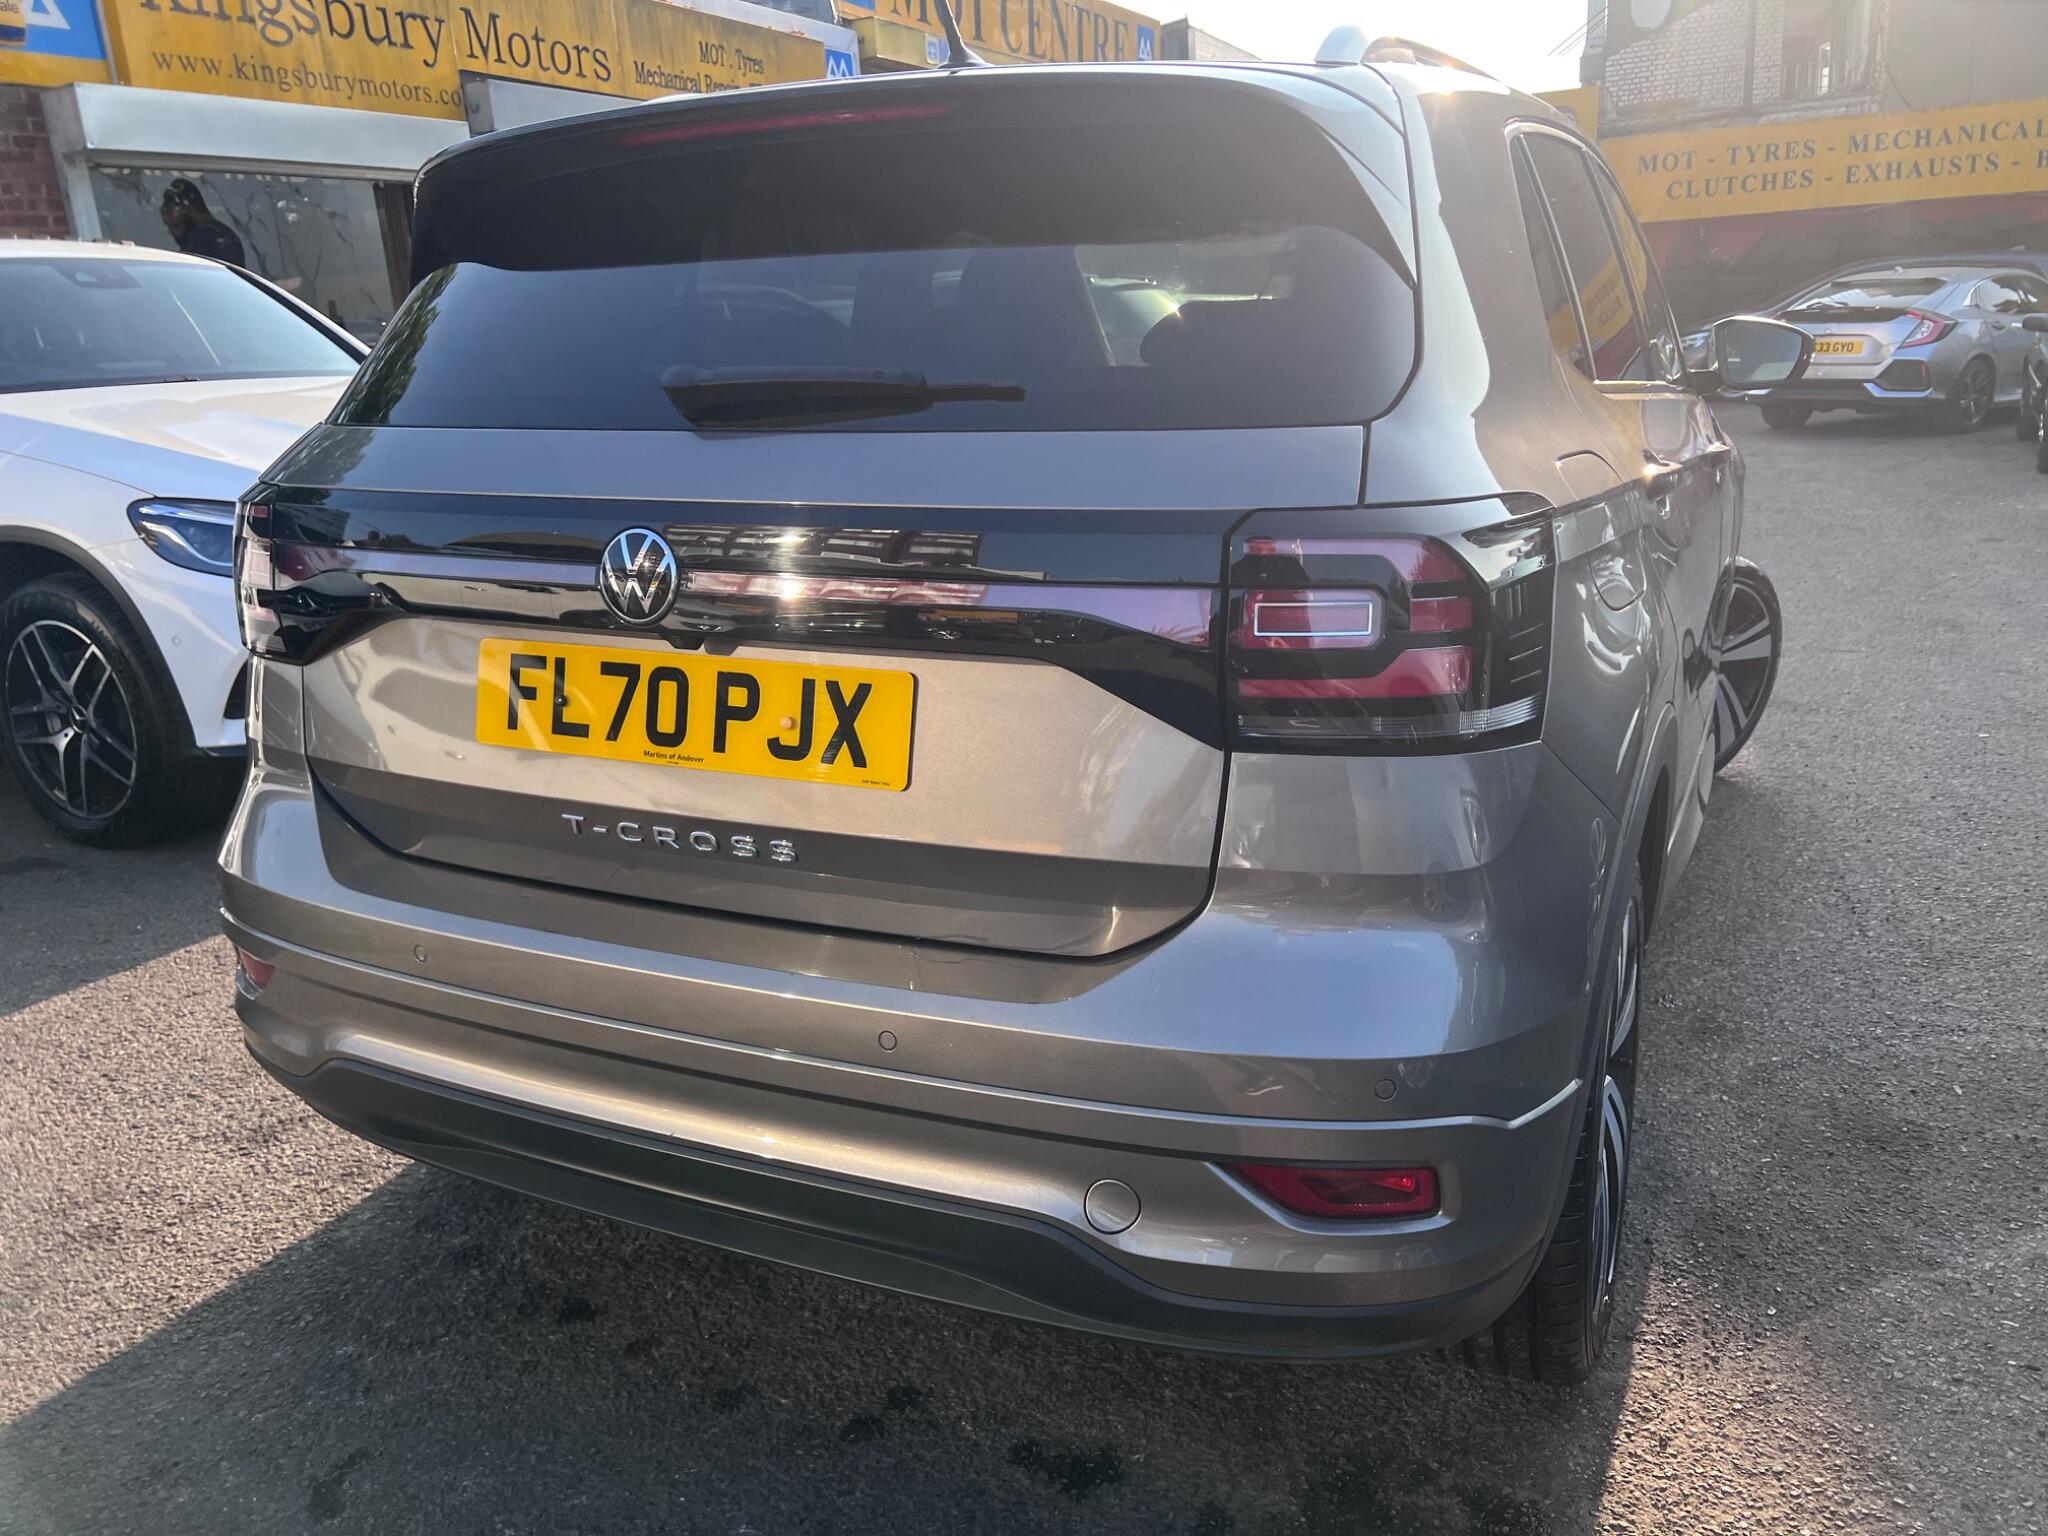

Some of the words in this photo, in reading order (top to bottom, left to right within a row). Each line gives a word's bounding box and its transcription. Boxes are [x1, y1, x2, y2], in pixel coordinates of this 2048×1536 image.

[140, 0, 446, 68] ngsbury
[459, 7, 612, 83] Motors
[699, 41, 725, 68] MOT
[735, 48, 765, 76] Tyres
[634, 61, 702, 94] Mechanical
[1638, 150, 1697, 175] MOT
[1727, 139, 1817, 167] TYRES
[1848, 118, 2048, 154] MECHANICAL
[1666, 169, 1814, 200] CLUTCHES
[1845, 151, 2000, 184] EXHAUSTS
[507, 653, 690, 748] FL70
[712, 671, 873, 769] PJX
[643, 749, 668, 760] Martins
[677, 754, 704, 763] Andover
[562, 813, 799, 863] T-CROSS
